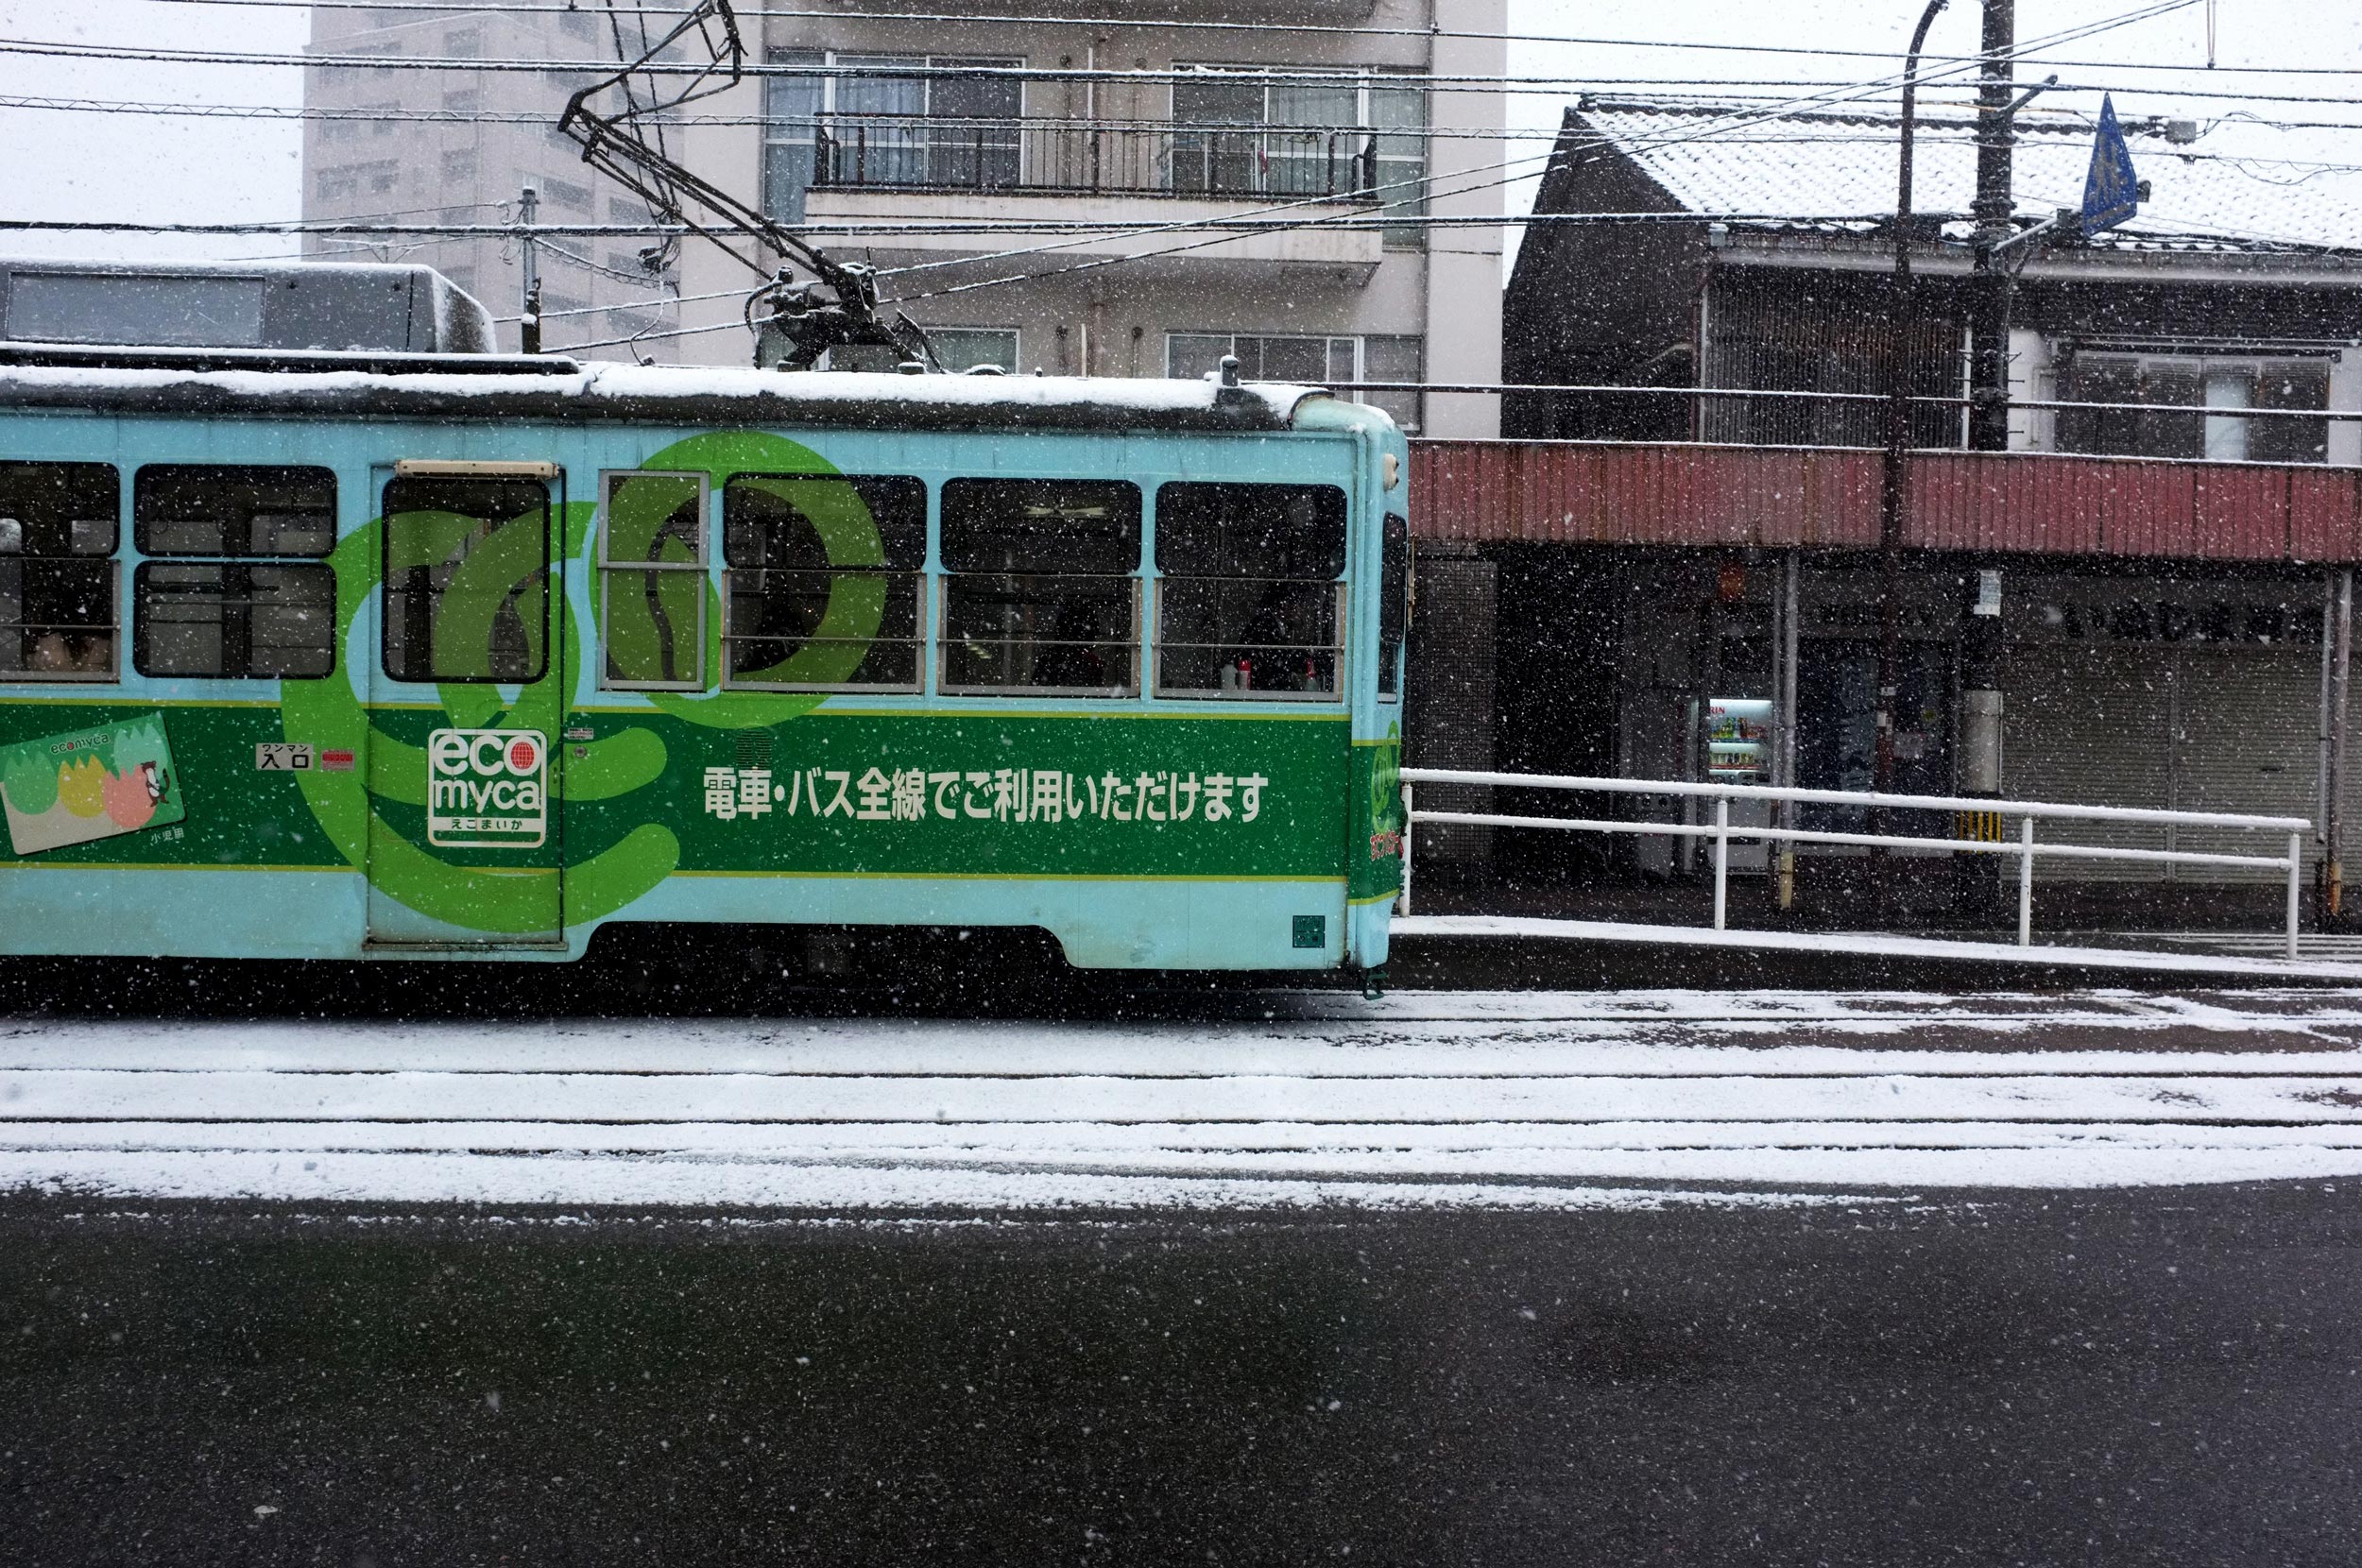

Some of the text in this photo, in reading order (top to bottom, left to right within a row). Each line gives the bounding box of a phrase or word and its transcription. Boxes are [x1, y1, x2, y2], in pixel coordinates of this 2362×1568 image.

[51, 734, 109, 754] ecomyca
[262, 743, 308, 753] ワンマン
[261, 753, 309, 769] 入口
[435, 735, 541, 776] eco
[435, 779, 541, 813] myca
[703, 766, 1269, 823] 電車・バス全線でご利用いただけます
[452, 819, 522, 830] えこまいか
[150, 827, 185, 844] 小児用
